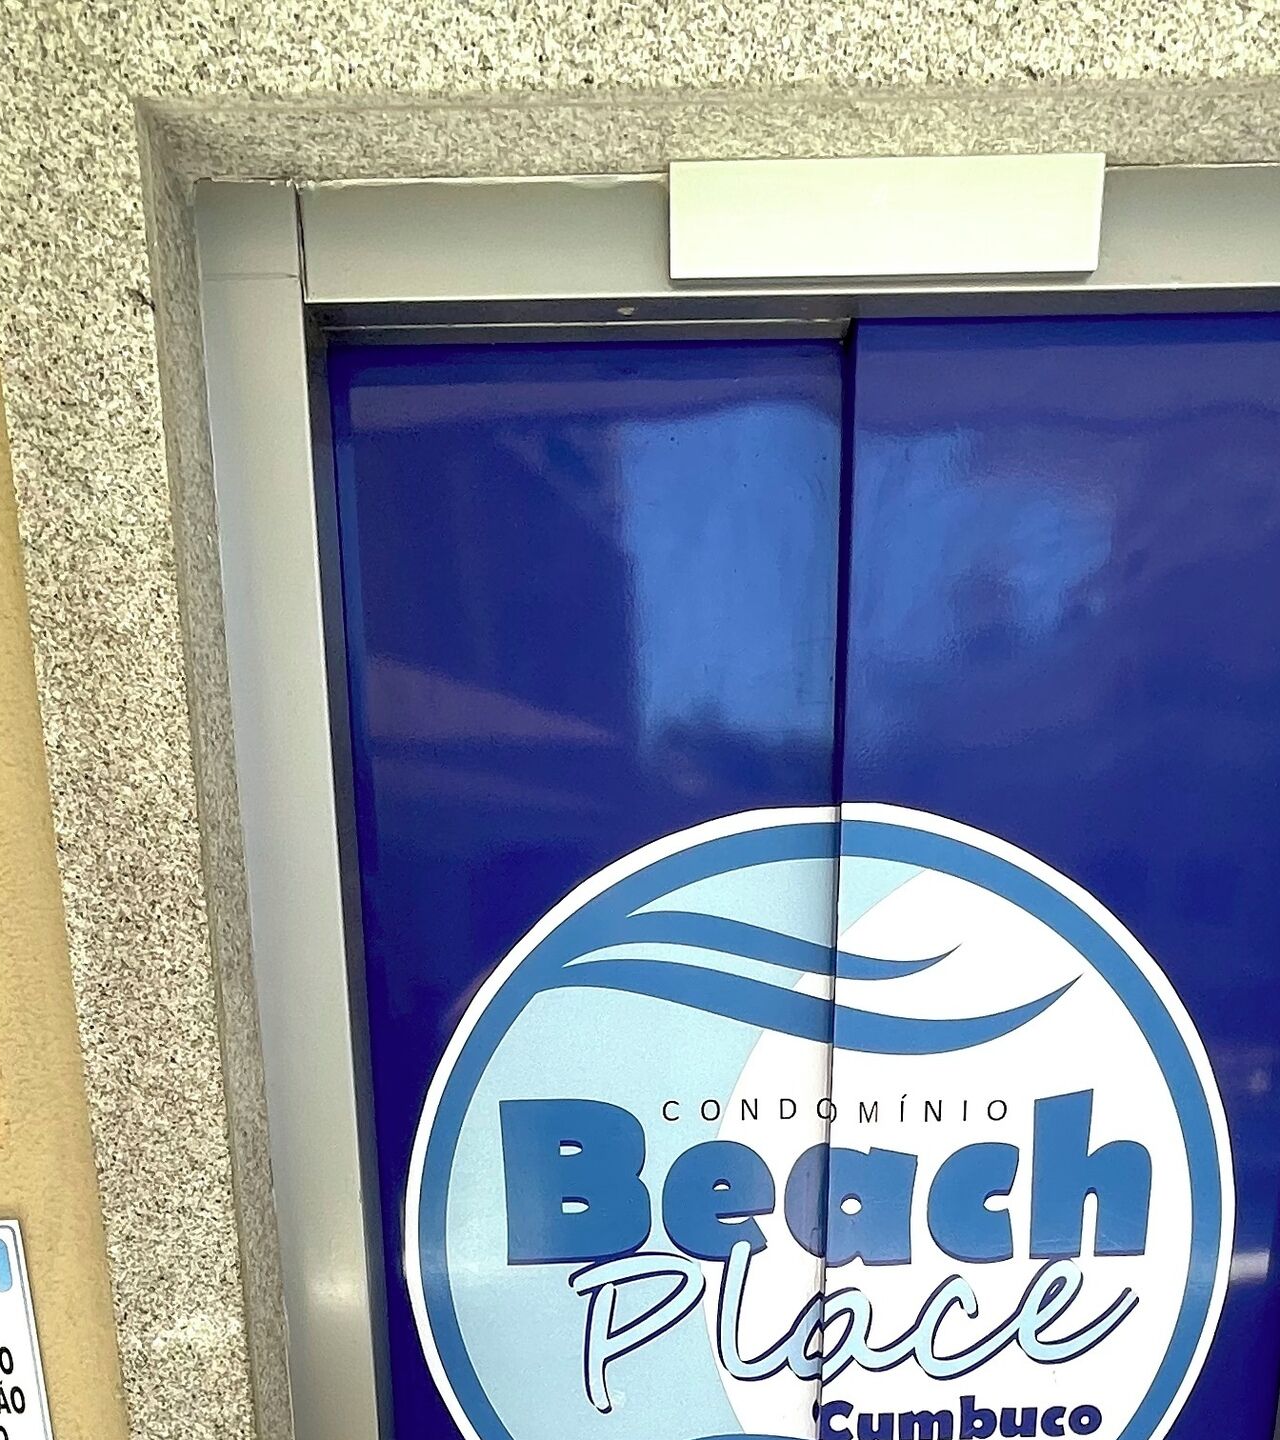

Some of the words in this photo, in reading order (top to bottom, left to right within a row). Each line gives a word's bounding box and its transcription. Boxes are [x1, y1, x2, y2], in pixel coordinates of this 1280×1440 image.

[498, 1088, 1153, 1267] Beach
[662, 1094, 1010, 1124] CONDOMÍNIO
[568, 1240, 1140, 1413] Place
